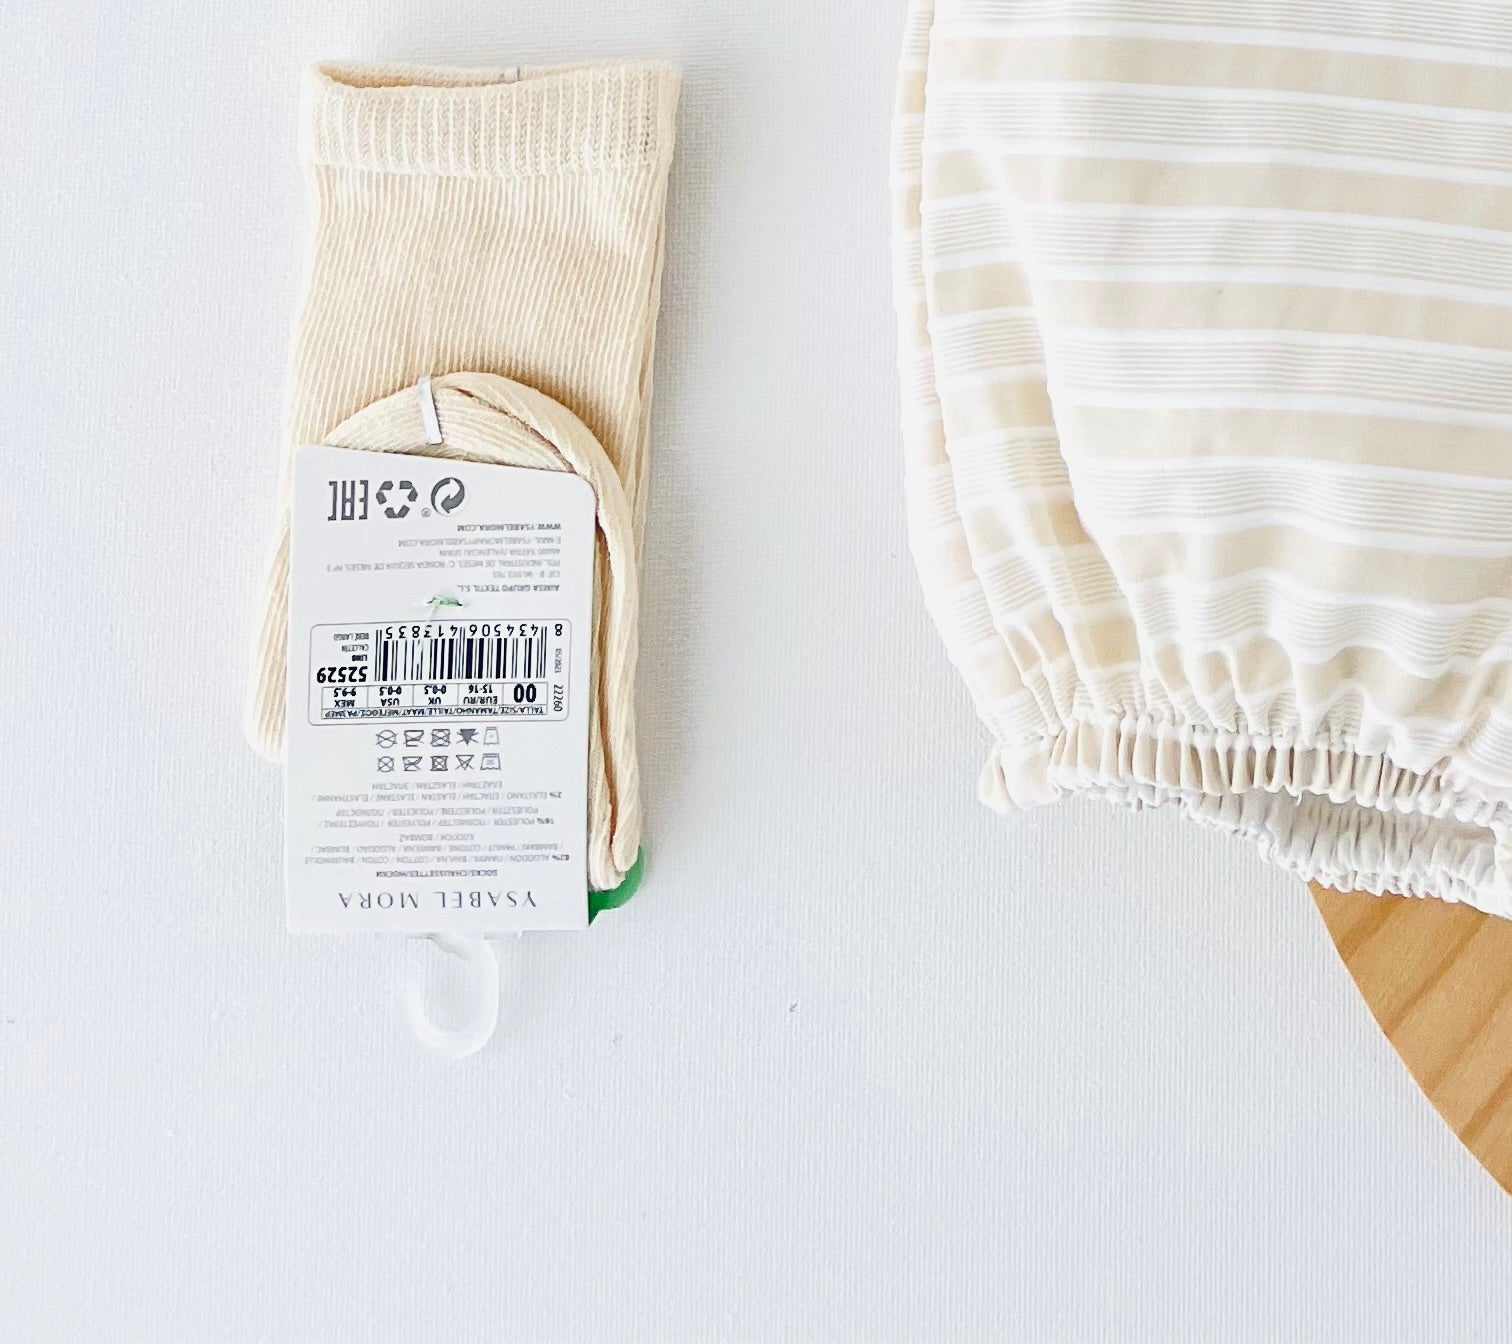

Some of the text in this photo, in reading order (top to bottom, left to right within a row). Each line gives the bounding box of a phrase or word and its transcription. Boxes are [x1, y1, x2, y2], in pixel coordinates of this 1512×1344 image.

[327, 479, 369, 522] EAC
[385, 623, 563, 640] 8 434506 413835
[316, 665, 368, 684] 52529
[467, 684, 493, 694] 15-16
[513, 683, 537, 703] 00
[553, 684, 563, 712] 22260
[333, 695, 498, 709] EUR/RU UK USA MEX
[338, 891, 536, 909] YSABEL MORA
